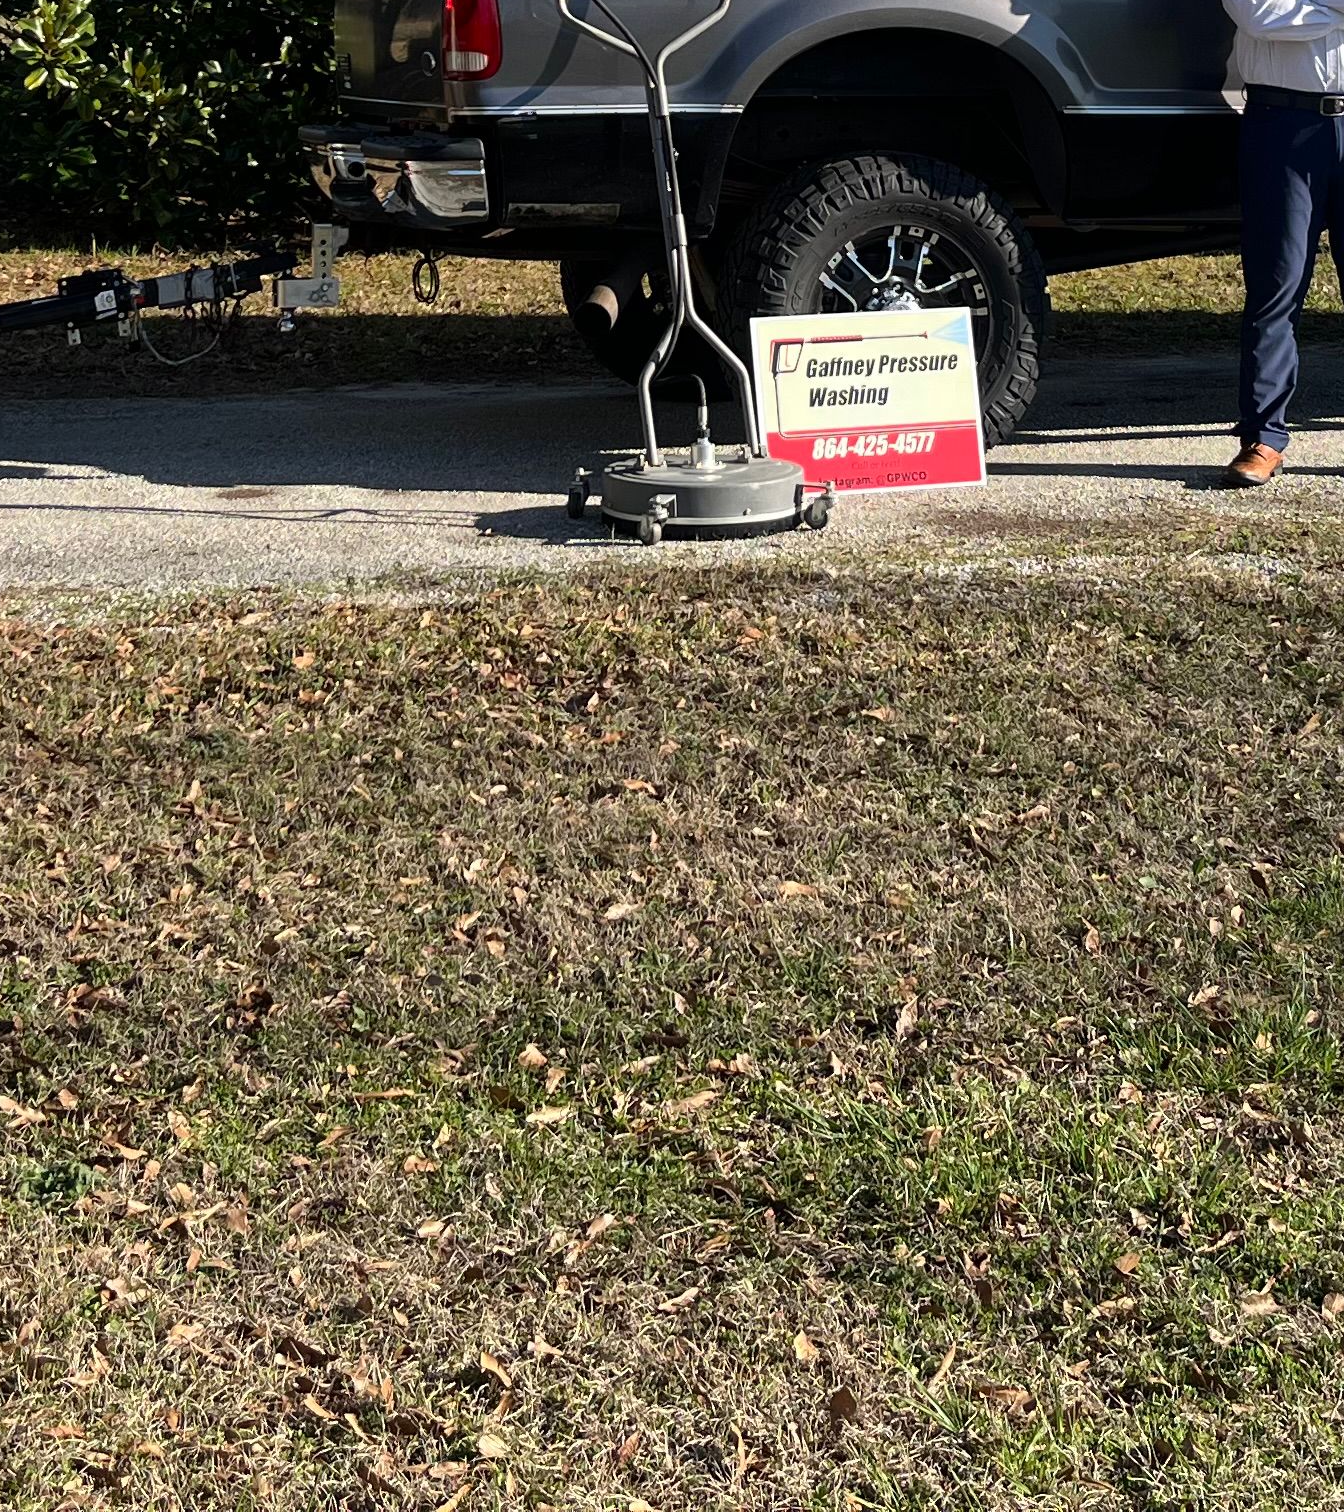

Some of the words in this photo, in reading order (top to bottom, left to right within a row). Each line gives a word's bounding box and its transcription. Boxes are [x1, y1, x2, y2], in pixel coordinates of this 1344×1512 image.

[806, 357, 875, 378] Gaffney
[878, 353, 958, 374] Pressure
[809, 385, 889, 407] Washing
[812, 431, 935, 460] 864-425-4577
